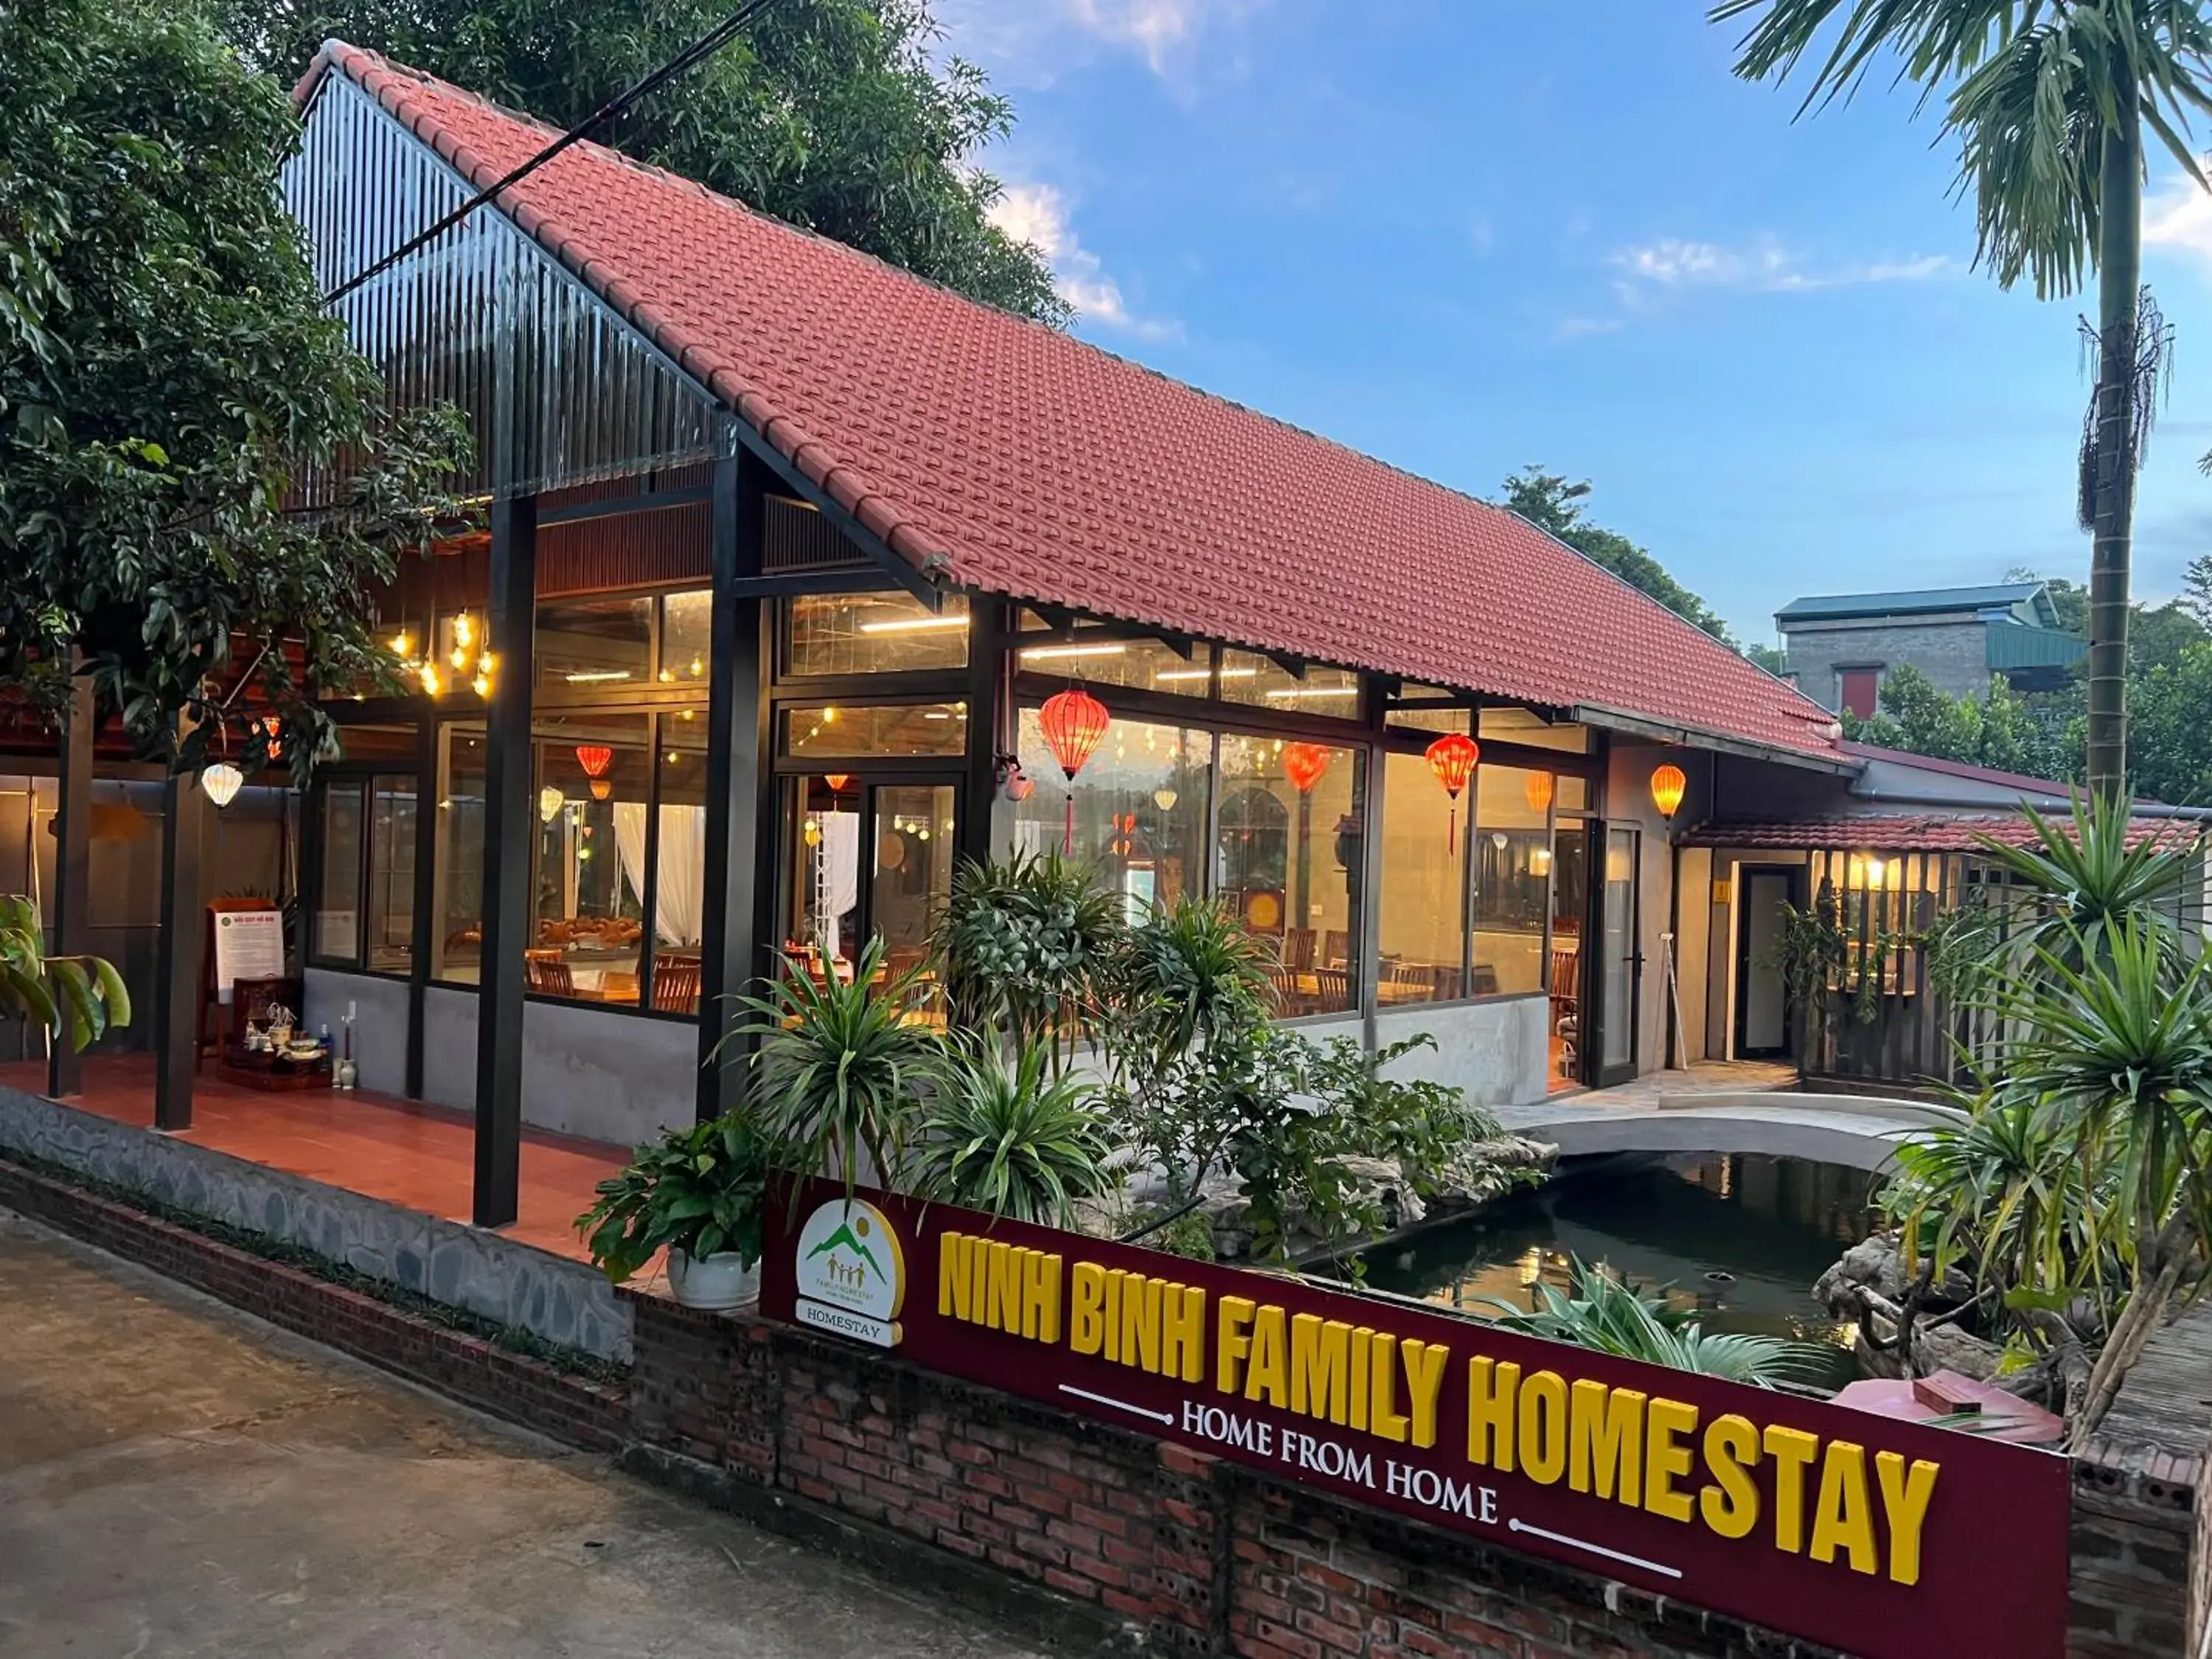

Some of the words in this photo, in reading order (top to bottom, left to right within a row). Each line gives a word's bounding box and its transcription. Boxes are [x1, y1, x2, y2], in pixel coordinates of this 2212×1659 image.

[807, 1307, 880, 1338] HOMESTAY
[938, 1231, 1062, 1344] NINH
[1070, 1261, 1206, 1383] BINH
[1217, 1295, 1450, 1448] FAMILY
[1467, 1355, 1940, 1586] HOMESTAY
[1182, 1400, 1273, 1456] HOME
[1281, 1428, 1376, 1489] FROM
[1385, 1459, 1498, 1524] HOME
